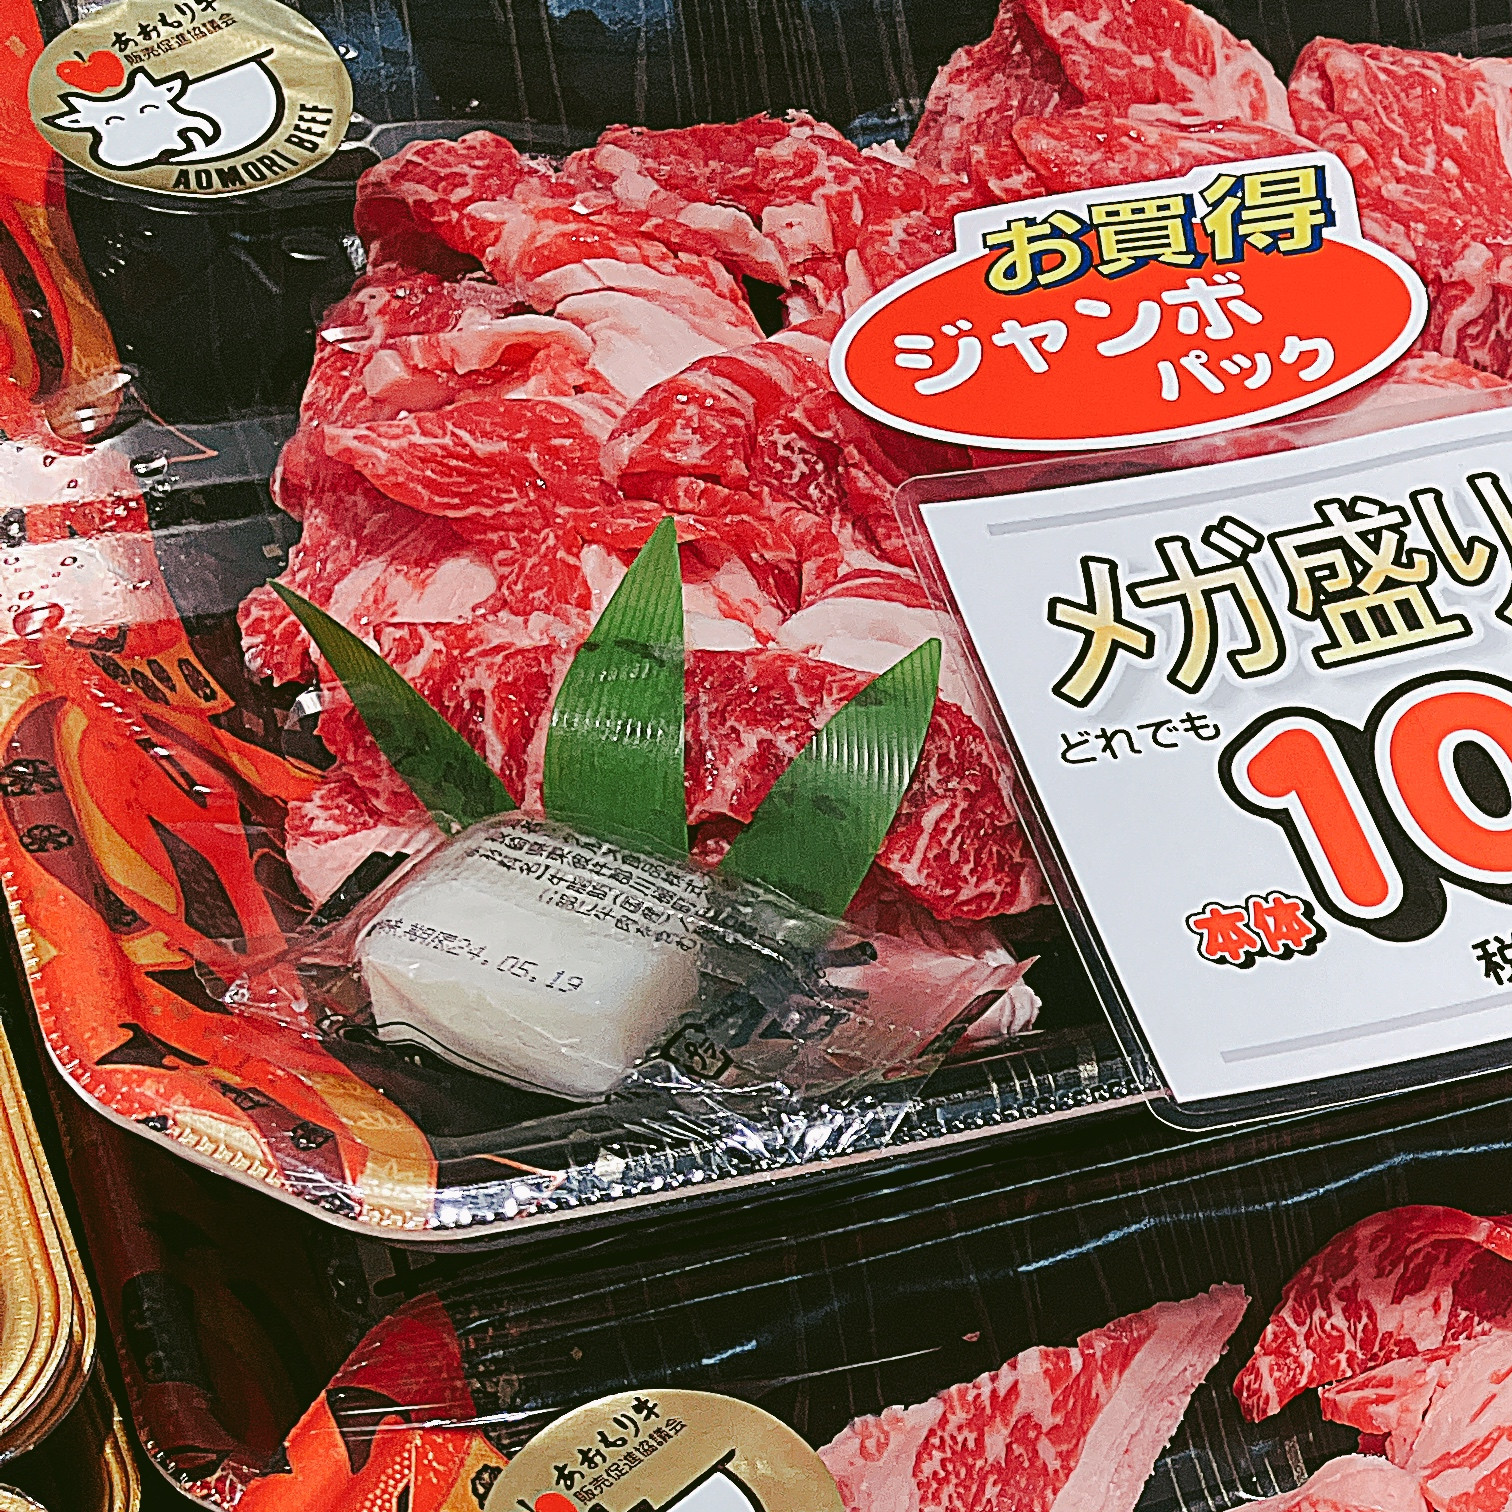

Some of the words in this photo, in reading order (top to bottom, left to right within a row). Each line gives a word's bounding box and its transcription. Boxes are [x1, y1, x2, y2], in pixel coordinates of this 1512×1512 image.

[172, 148, 299, 190] AOMORI
[285, 103, 334, 154] BEEF
[983, 165, 1337, 295] お買得
[894, 271, 1264, 395] ジャンボ
[1159, 334, 1336, 402] パック
[1058, 710, 1221, 765] どれでも
[1184, 891, 1327, 969] 本体
[555, 1396, 661, 1491] あおもり牛
[573, 1416, 688, 1506] 販売促進協議会
